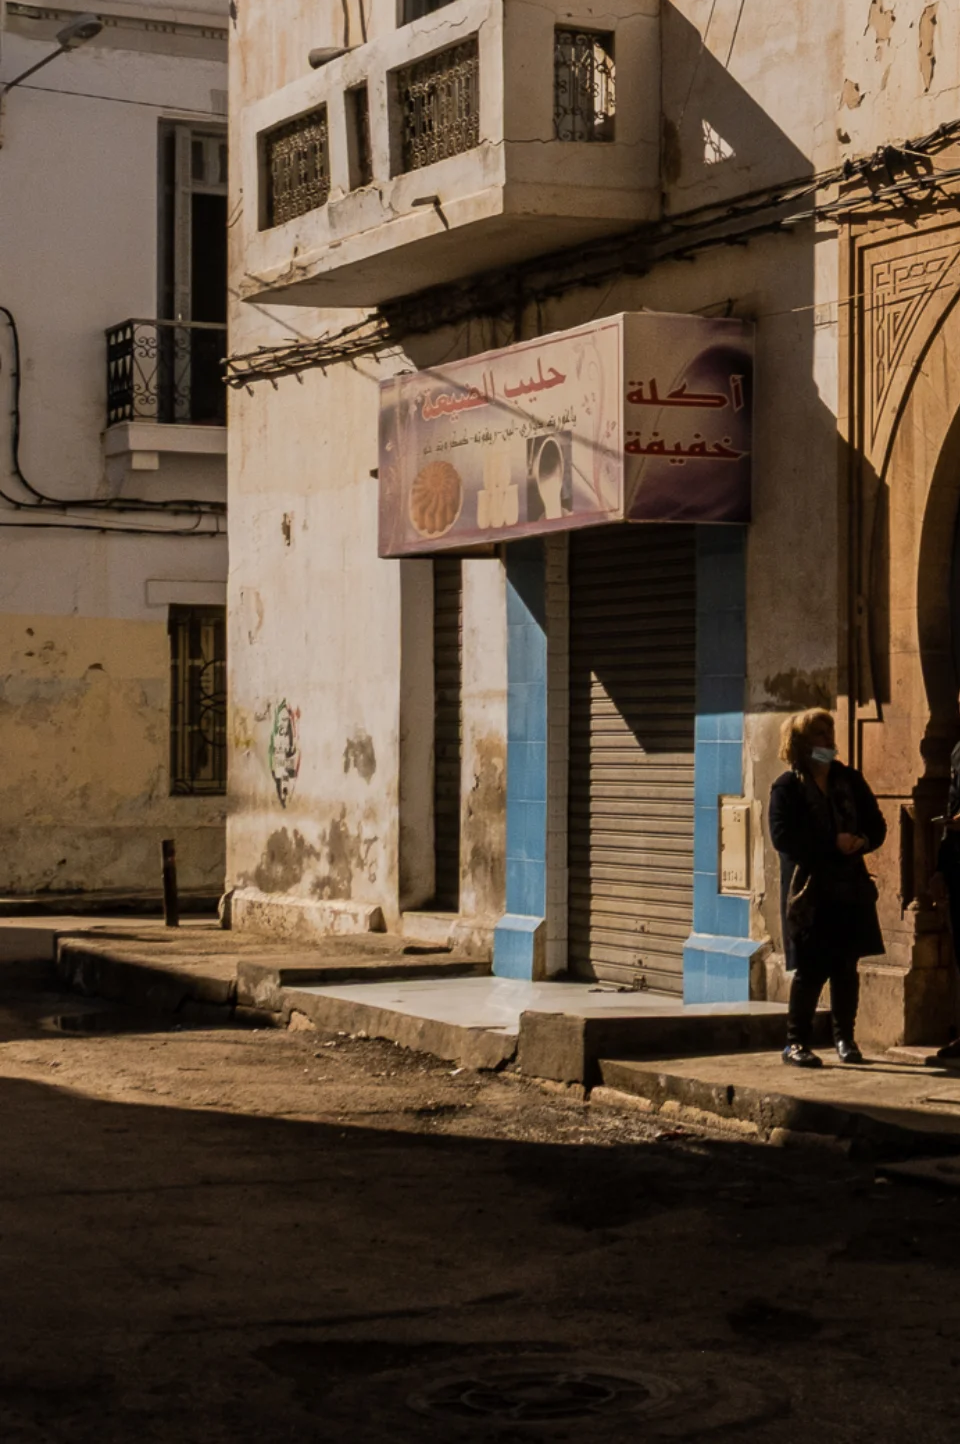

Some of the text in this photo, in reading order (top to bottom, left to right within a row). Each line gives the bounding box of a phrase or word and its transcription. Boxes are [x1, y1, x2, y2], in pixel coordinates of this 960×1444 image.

[503, 357, 567, 406] حليب
[626, 374, 745, 413] أكلة
[624, 431, 752, 466] خفيفة
